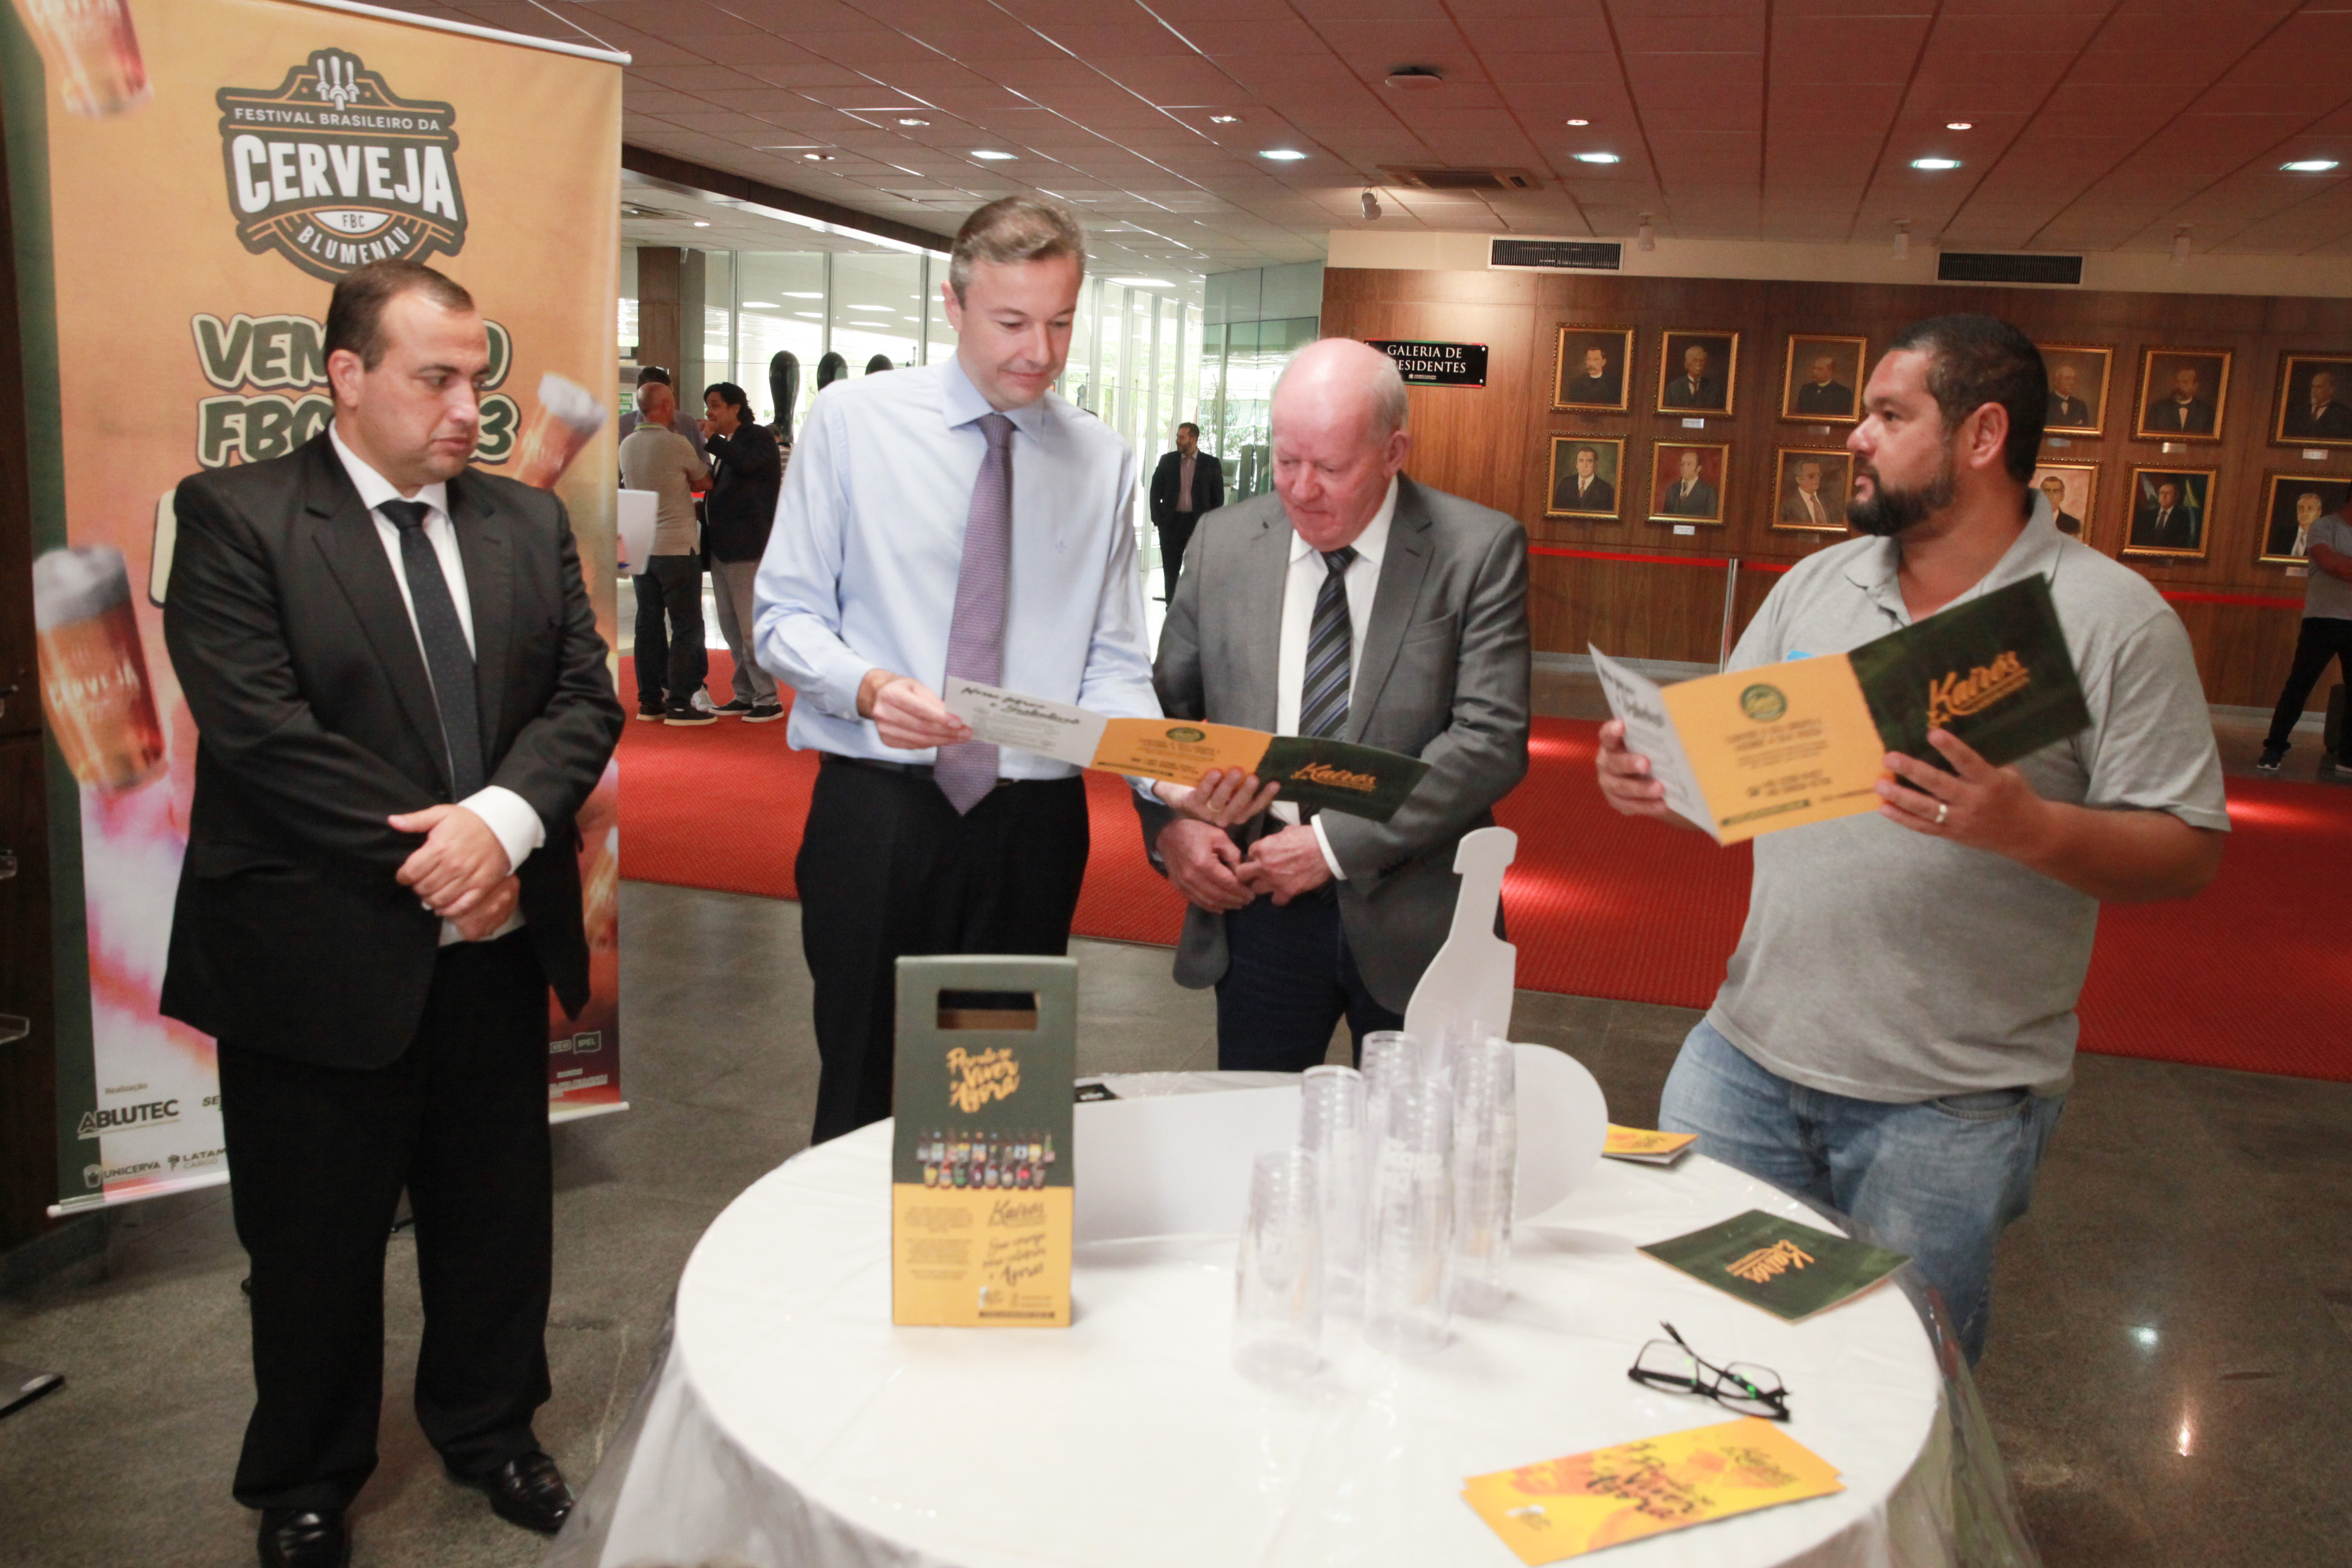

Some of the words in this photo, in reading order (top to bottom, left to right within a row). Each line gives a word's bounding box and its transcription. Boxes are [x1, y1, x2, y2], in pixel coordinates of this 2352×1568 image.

[234, 108, 314, 124] FESTIVAL
[319, 113, 413, 130] BRASILEIRO
[418, 118, 440, 131] DA
[232, 134, 458, 222] CERVEJA
[342, 214, 365, 229] FBC
[297, 225, 411, 265] BLUMENAU
[1387, 345, 1441, 357] GALERIA
[1445, 347, 1462, 358] DE
[77, 1099, 179, 1133] ABLUTEC
[104, 1161, 161, 1178] UNICERVA
